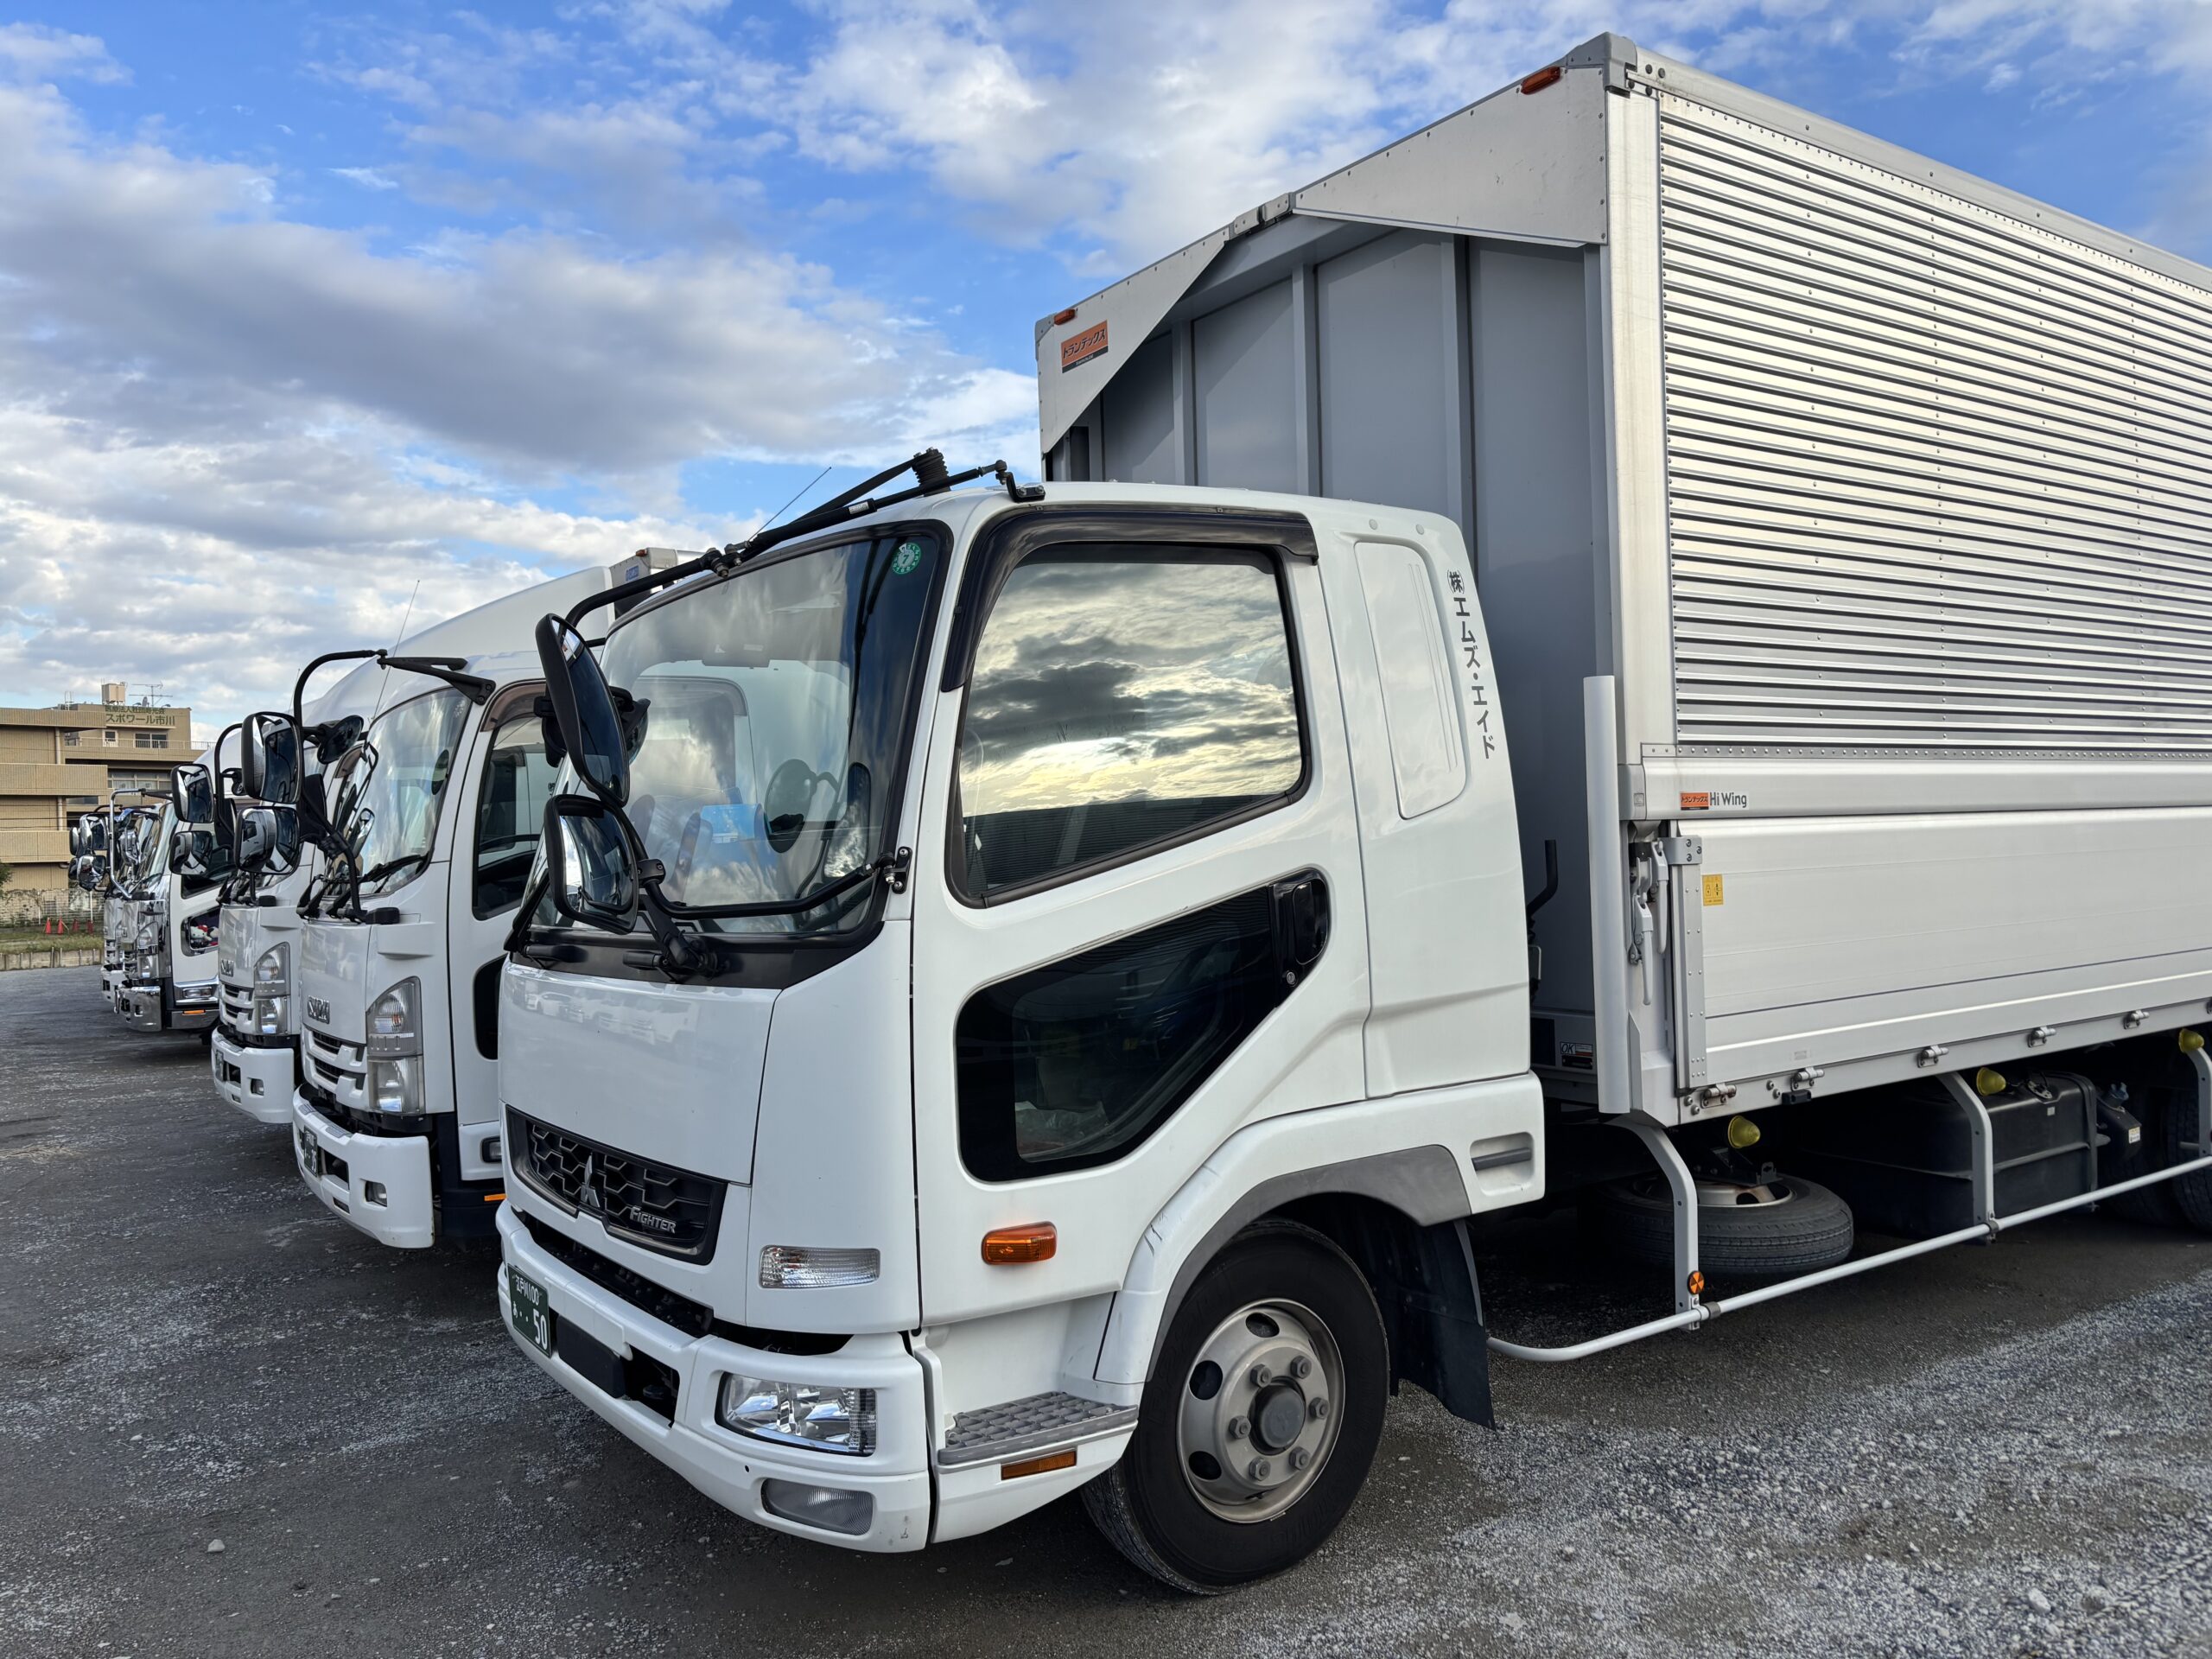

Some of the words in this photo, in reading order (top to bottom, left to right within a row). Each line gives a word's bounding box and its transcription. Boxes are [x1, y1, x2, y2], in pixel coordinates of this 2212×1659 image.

[1063, 328, 1107, 359] トランテックス
[1710, 791, 1719, 806] Hi
[1721, 791, 1747, 809] Wing
[629, 1205, 677, 1234] FIGHTER
[533, 1308, 548, 1351] 50
